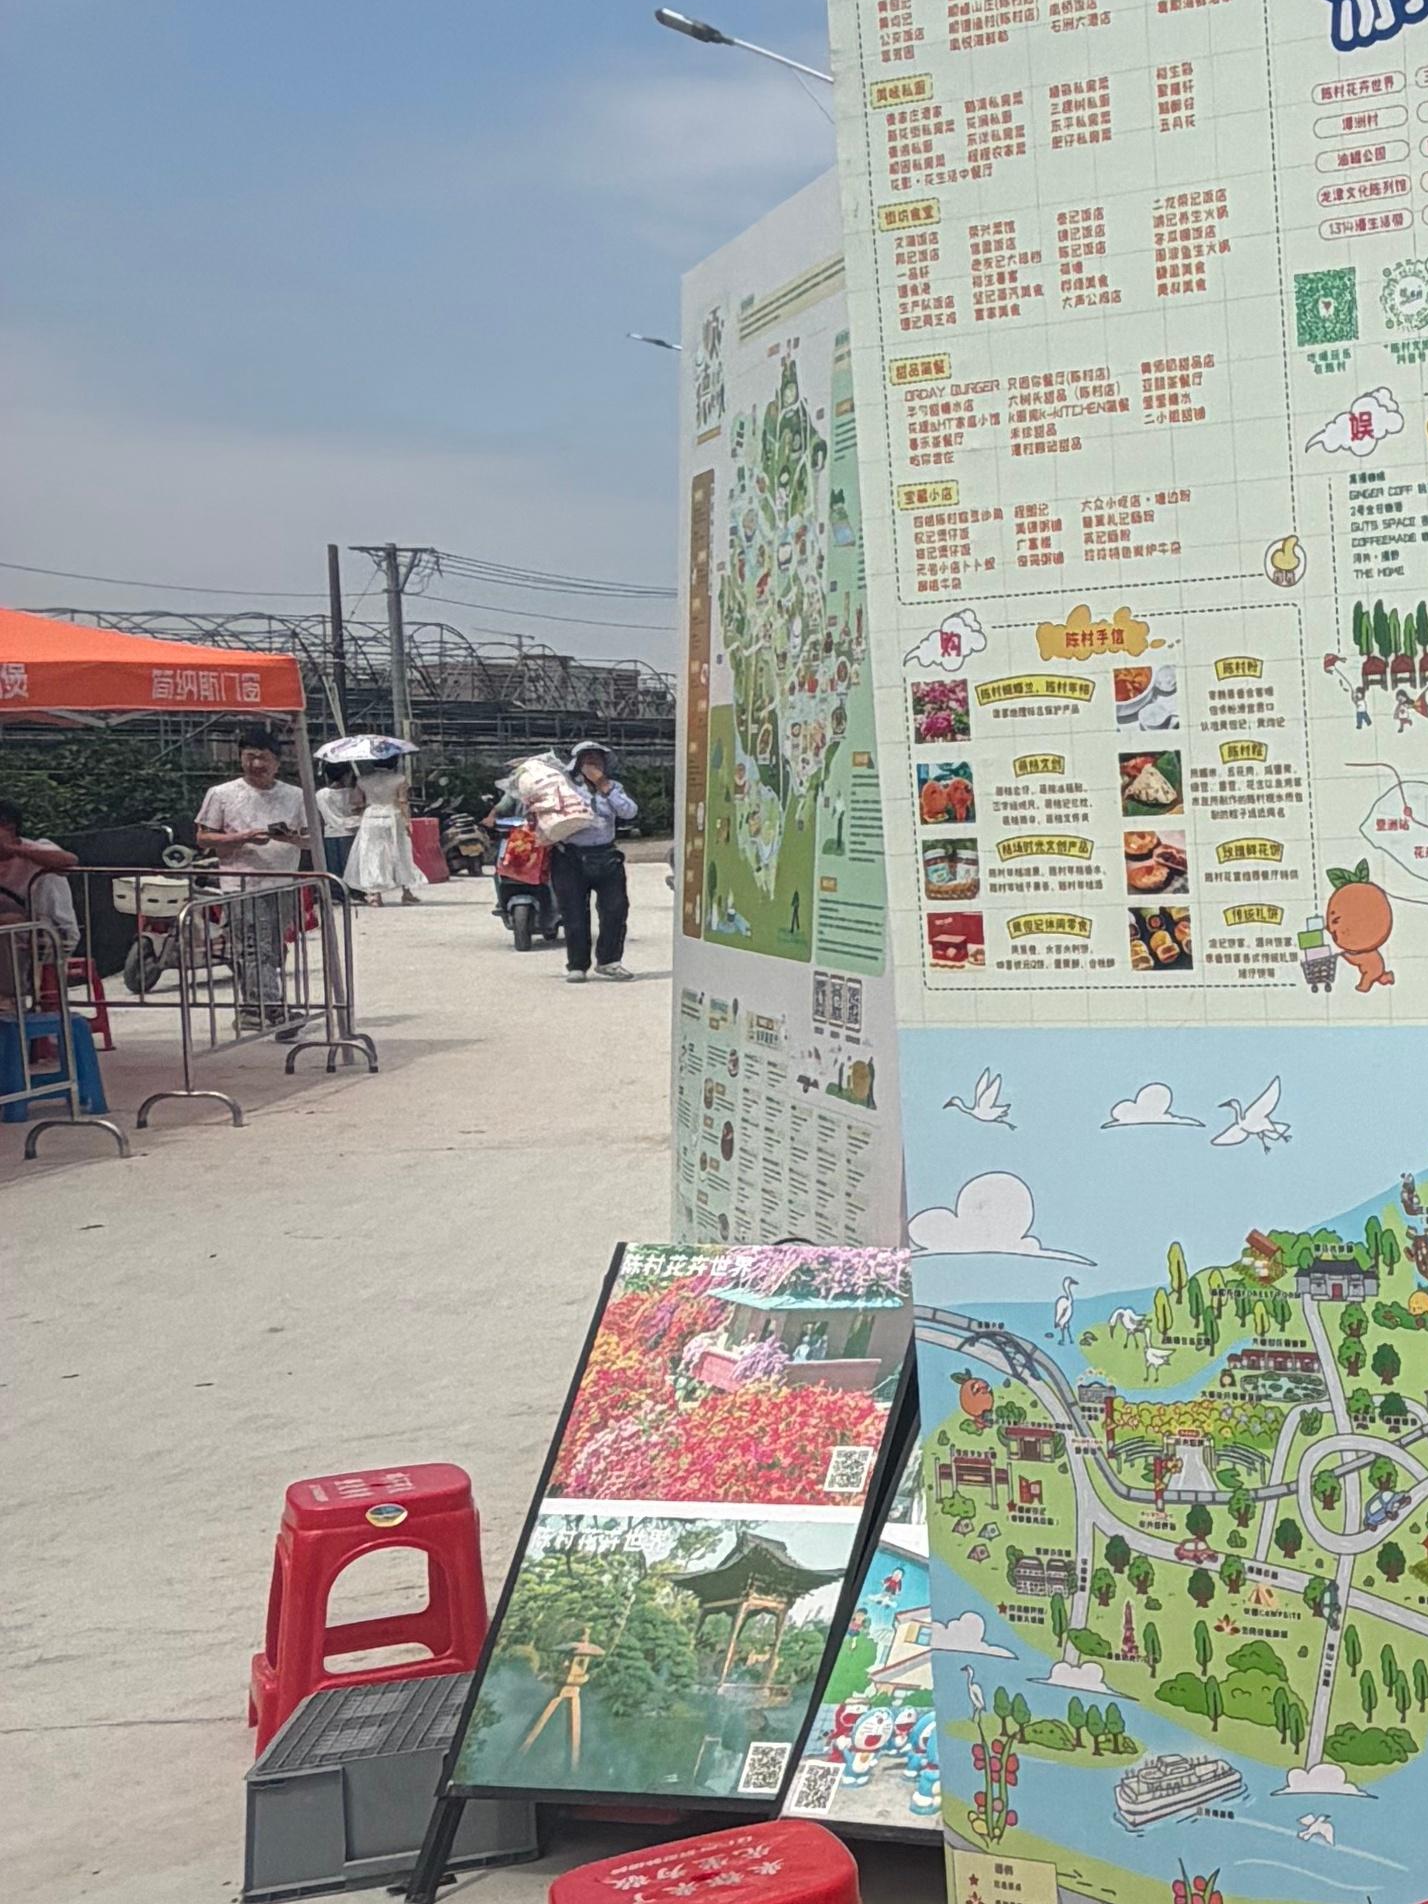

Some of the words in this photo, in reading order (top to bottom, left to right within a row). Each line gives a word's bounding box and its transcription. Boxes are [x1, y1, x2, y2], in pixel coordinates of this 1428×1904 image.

[1319, 74, 1396, 102] 陈村花卉世界
[1349, 411, 1376, 442] 娱
[1064, 628, 1127, 649] 陈村手信
[622, 1254, 755, 1278] 陈村花卉世界
